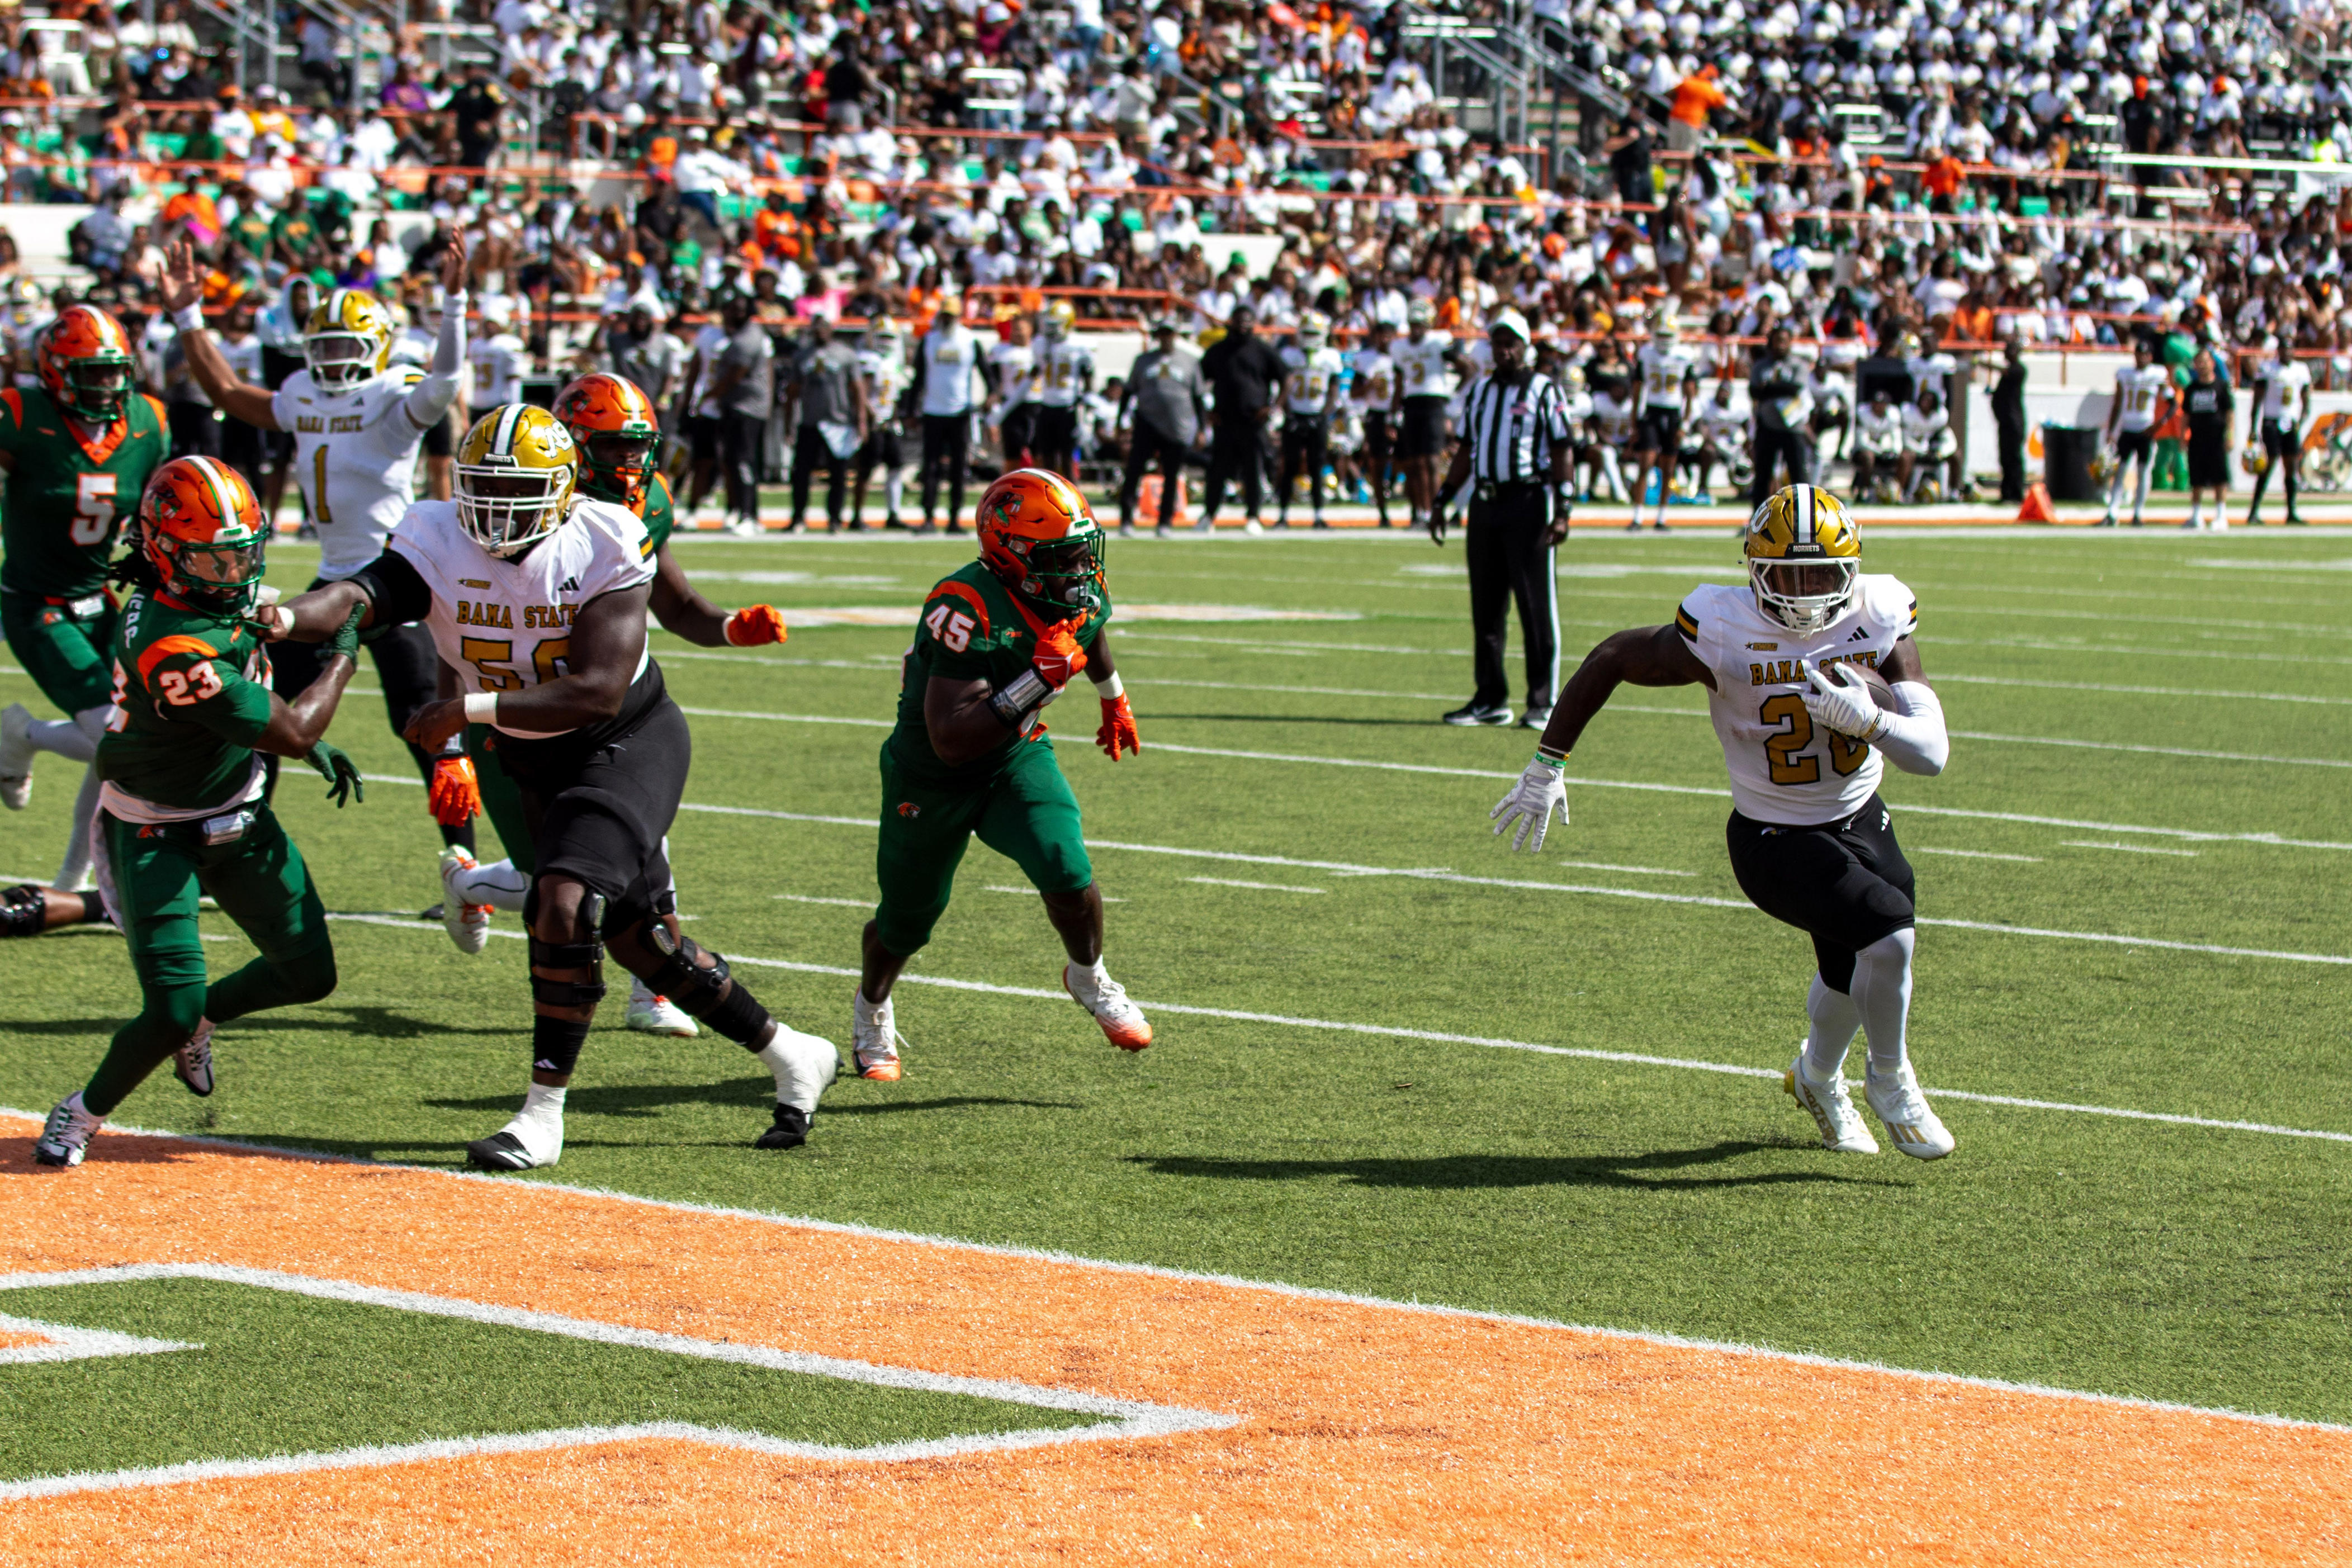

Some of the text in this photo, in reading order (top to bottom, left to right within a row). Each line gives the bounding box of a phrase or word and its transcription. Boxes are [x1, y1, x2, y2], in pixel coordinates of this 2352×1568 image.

[314, 444, 333, 523] 1
[69, 473, 116, 546] 5
[457, 600, 514, 629] BAMA
[925, 604, 976, 653] 45
[158, 660, 223, 705] 23
[1749, 660, 1807, 686] BAMA
